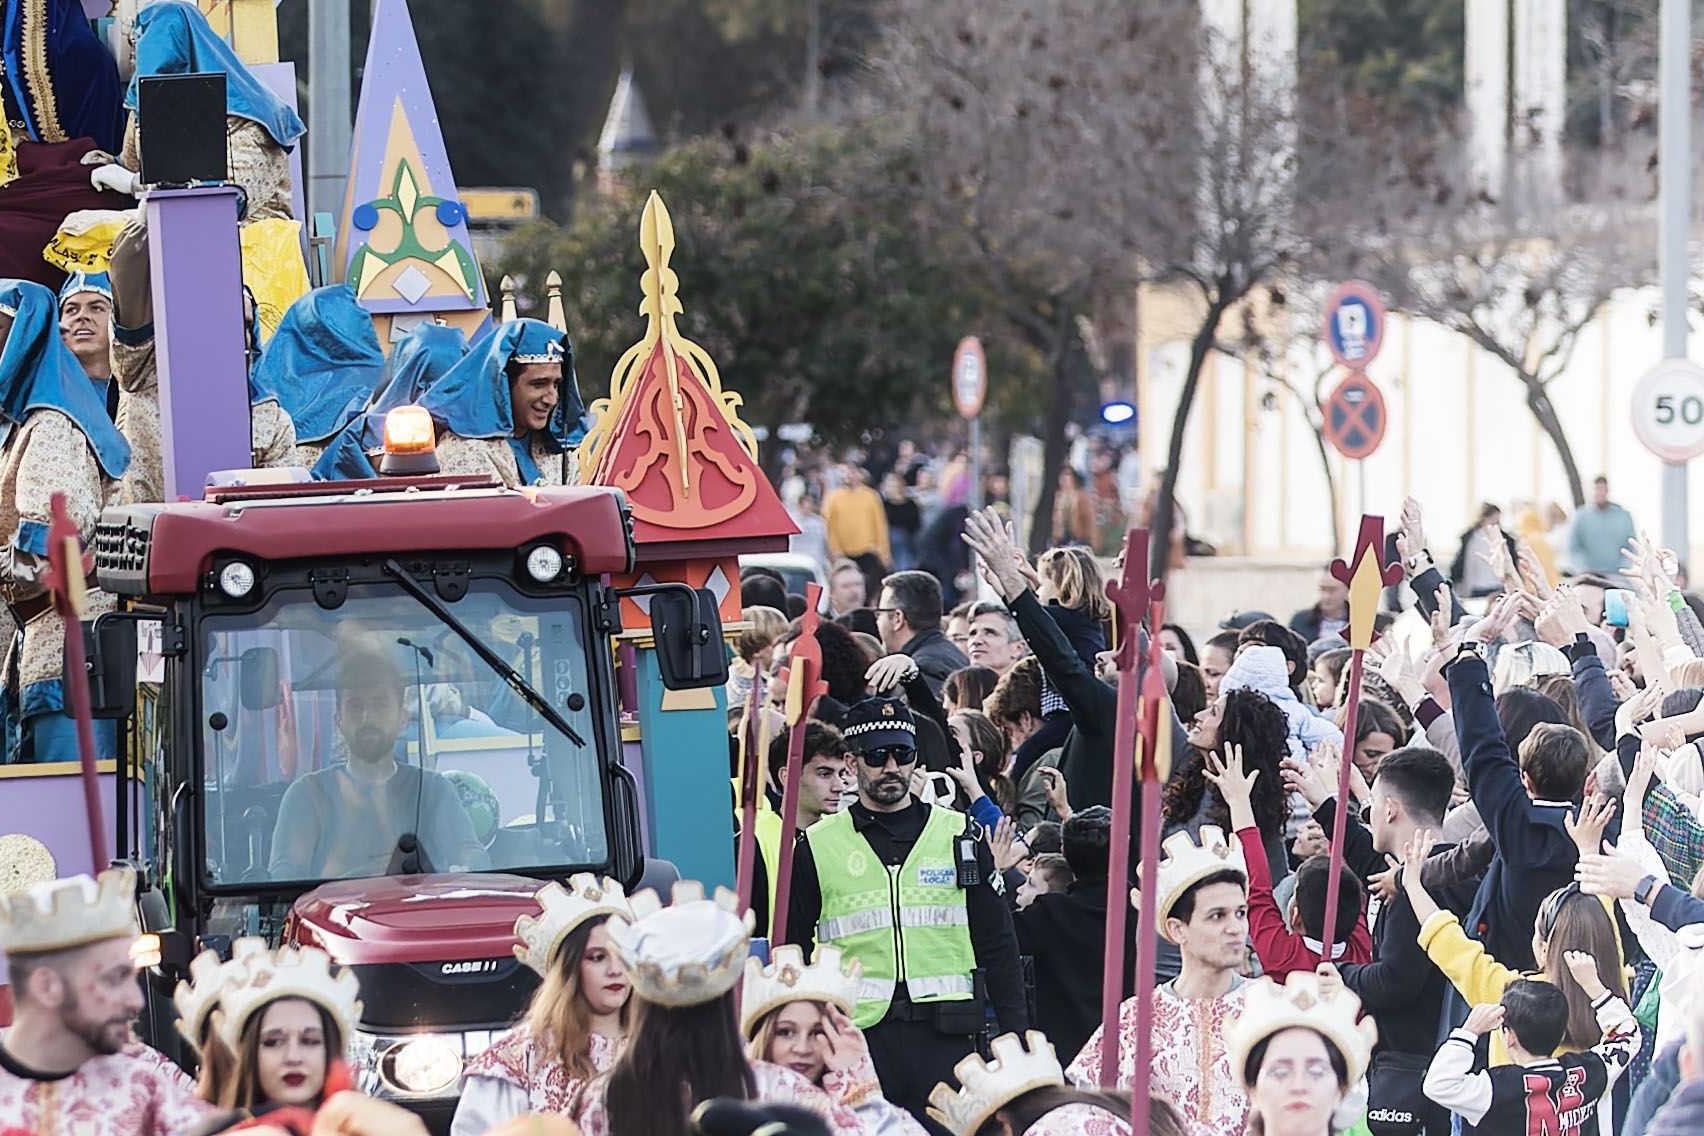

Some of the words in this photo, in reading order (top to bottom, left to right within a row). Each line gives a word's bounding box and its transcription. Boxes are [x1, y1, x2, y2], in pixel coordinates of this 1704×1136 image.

[1656, 396, 1704, 425] 50
[442, 961, 482, 974] CASE
[1368, 1109, 1412, 1123] adidas
